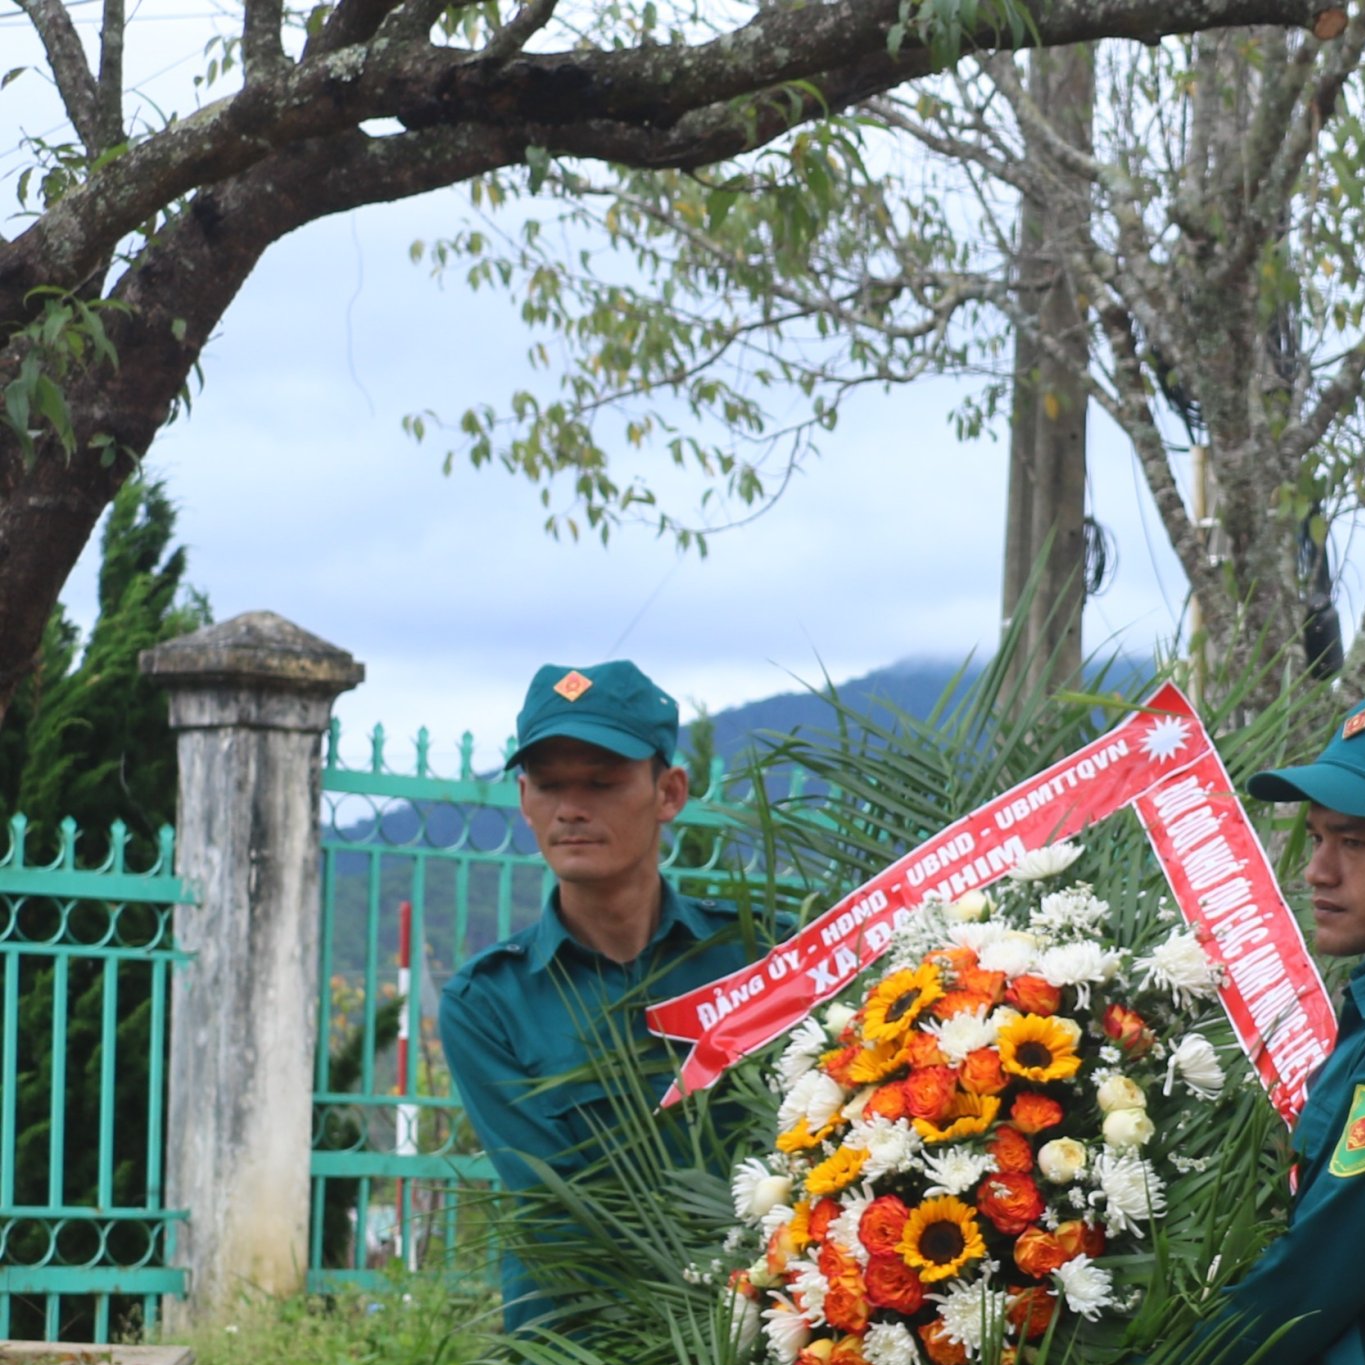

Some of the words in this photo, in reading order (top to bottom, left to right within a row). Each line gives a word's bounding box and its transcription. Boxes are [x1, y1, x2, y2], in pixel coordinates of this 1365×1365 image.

[696, 975, 765, 1032] ĐẢNG
[820, 889, 888, 947] HĐND
[906, 831, 975, 887] UBND
[993, 738, 1129, 831] UBMTTQVN
[1181, 835, 1249, 891] NHỚ
[806, 942, 862, 995] XÃ
[921, 835, 1027, 902] NHIM
[1197, 876, 1253, 920] ƠN
[1211, 904, 1274, 959] CÁC
[1229, 943, 1286, 1001] ANH
[1248, 977, 1309, 1054] HÙNG
